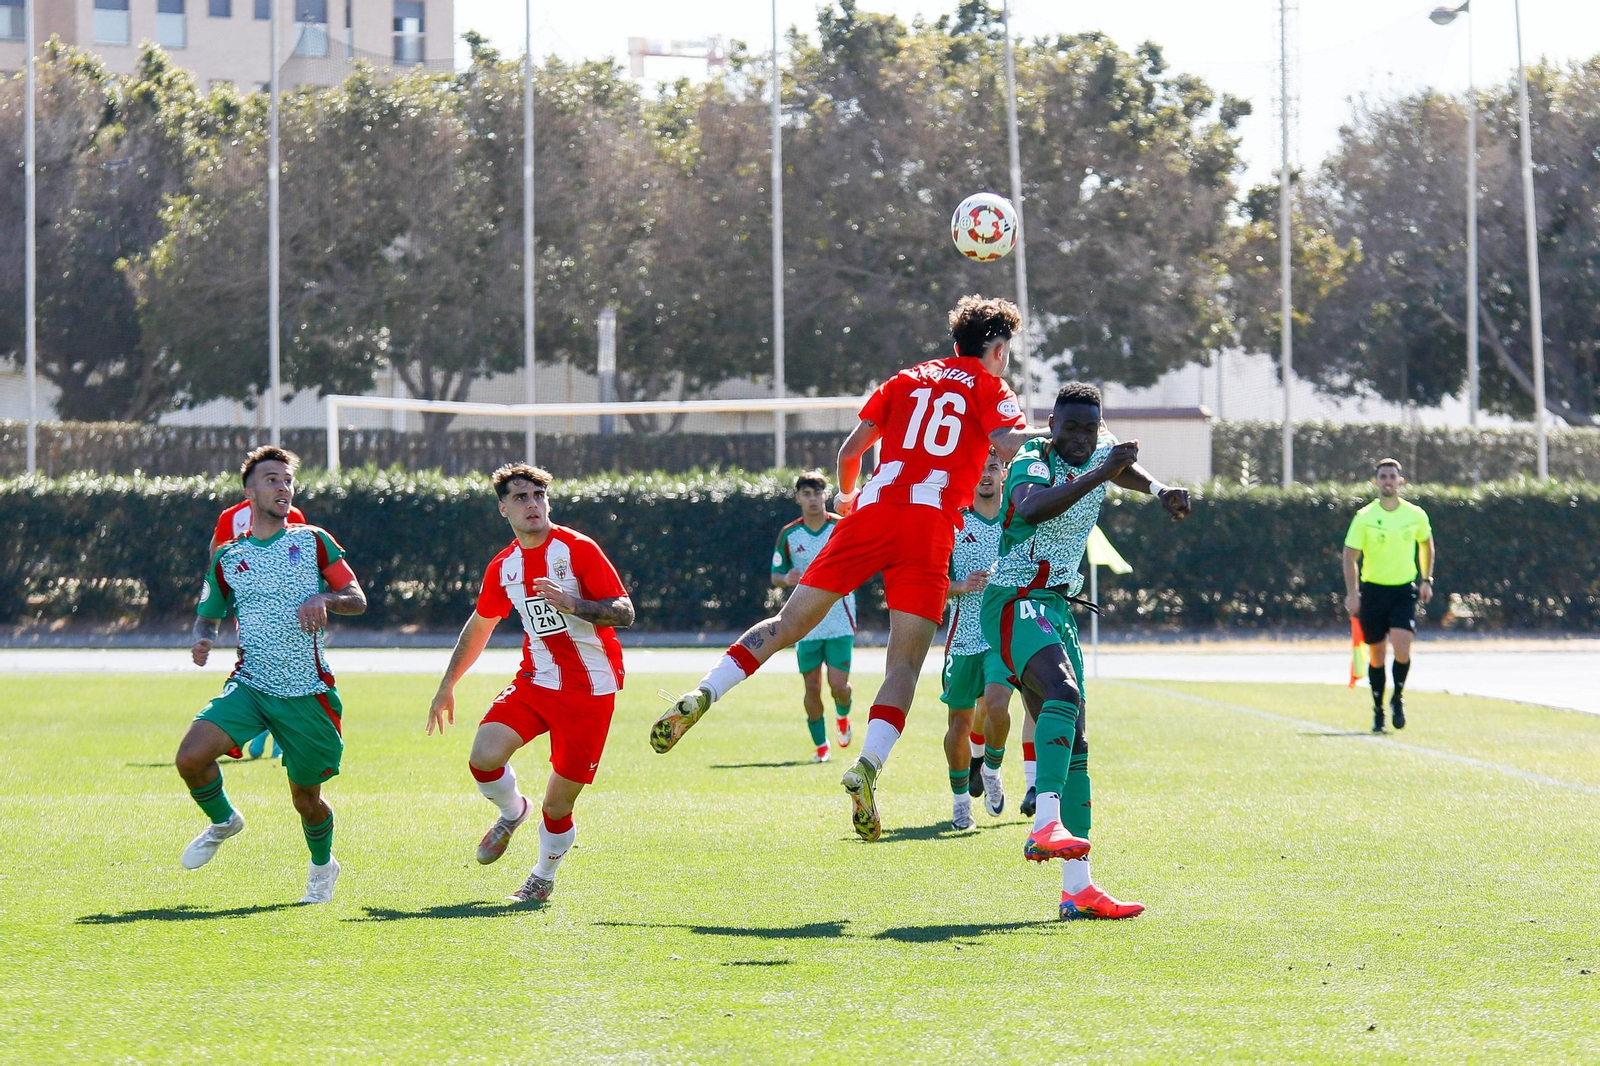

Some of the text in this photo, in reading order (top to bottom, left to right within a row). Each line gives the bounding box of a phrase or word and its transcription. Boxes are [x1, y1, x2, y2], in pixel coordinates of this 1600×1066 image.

[902, 387, 966, 456] 16
[533, 602, 553, 616] DA
[537, 615, 557, 628] ZN
